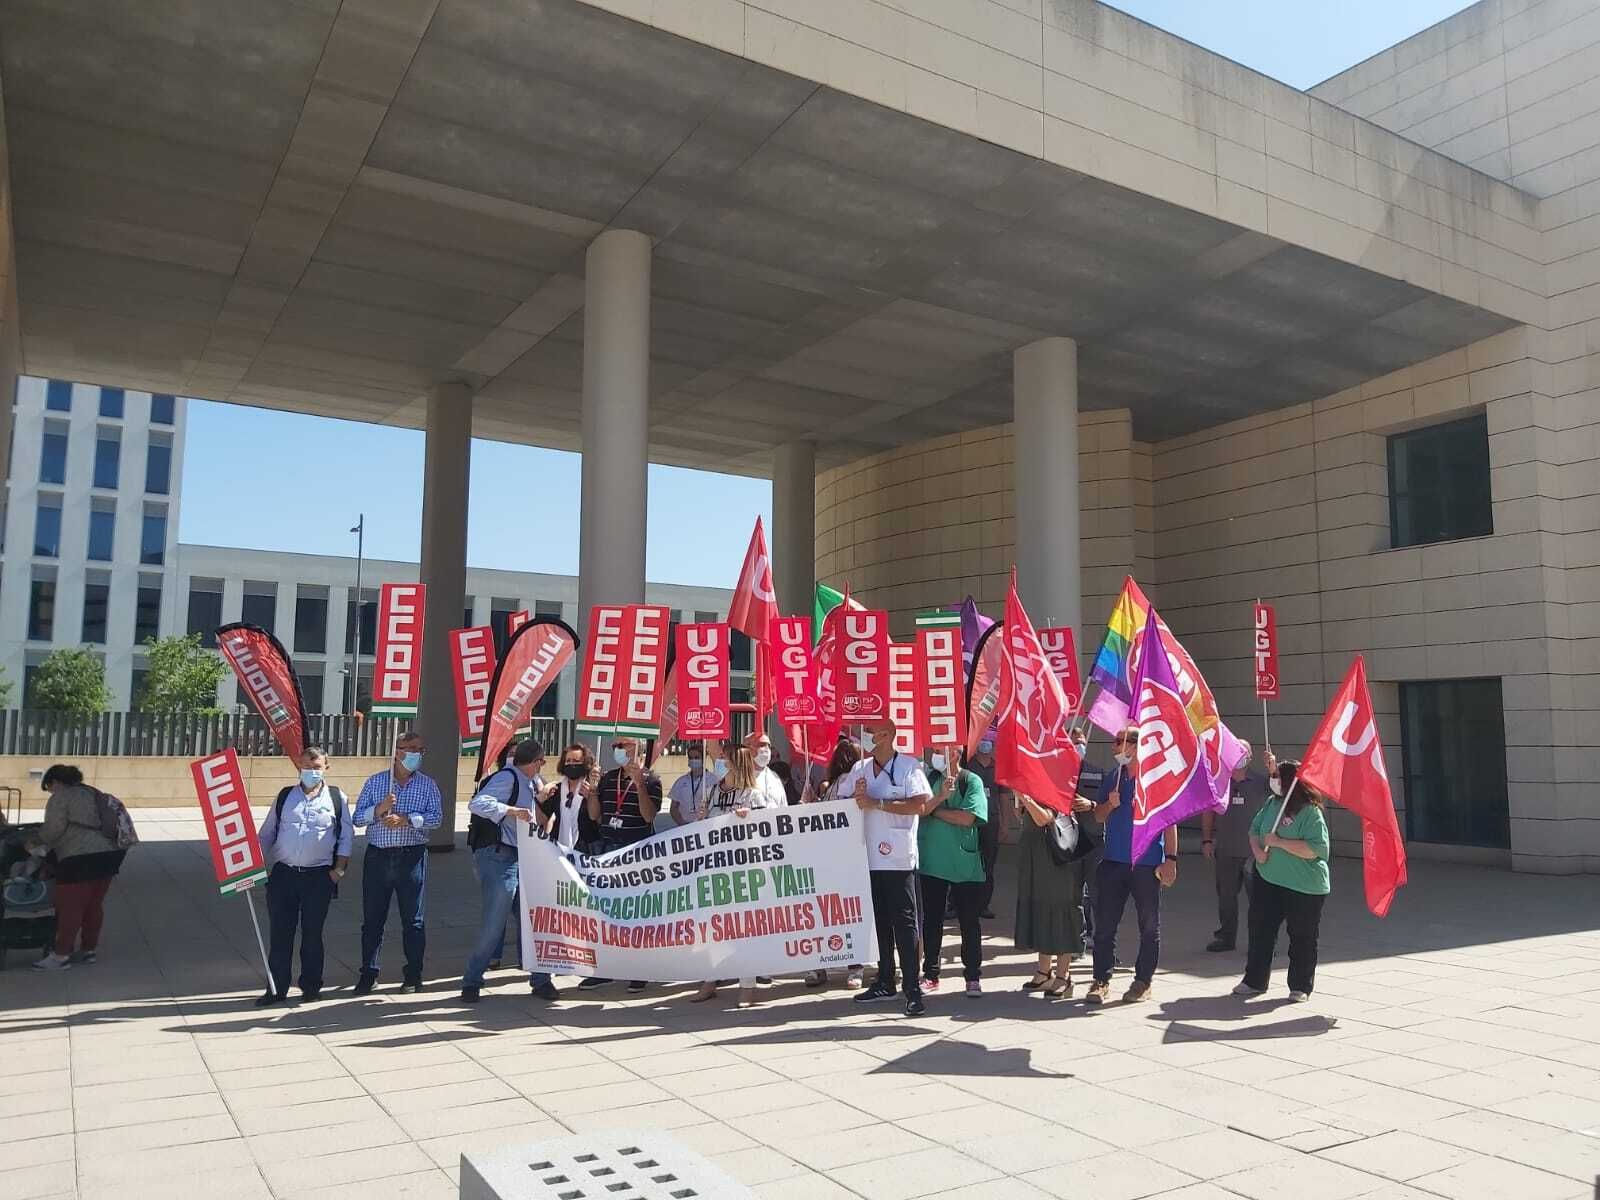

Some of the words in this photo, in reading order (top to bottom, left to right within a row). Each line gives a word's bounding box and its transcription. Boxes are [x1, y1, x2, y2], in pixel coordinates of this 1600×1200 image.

[225, 637, 280, 709] CCOO
[382, 587, 416, 699] CCOO
[509, 633, 564, 705] CCOO
[586, 609, 622, 718] CCOO
[627, 609, 660, 720] CCOO
[687, 628, 719, 706] UGT
[780, 623, 808, 694] UGT
[845, 616, 878, 691] UGT
[1256, 609, 1271, 671] UGT
[889, 647, 914, 753] CCOO
[201, 755, 253, 876] CCOO
[671, 833, 704, 855] DEL
[708, 821, 772, 845] GRUPO
[776, 814, 794, 836] B
[798, 811, 849, 833] PARA
[667, 885, 693, 915] DEL
[697, 866, 766, 908] EBEP
[770, 864, 816, 898] YA!!!
[670, 844, 785, 878] SUPERIORES
[601, 918, 695, 949] LABORALES
[711, 902, 816, 942] SALARIALES
[816, 893, 863, 927] YA!!!
[785, 936, 824, 957] UGT
[819, 952, 854, 962] Andalucía
